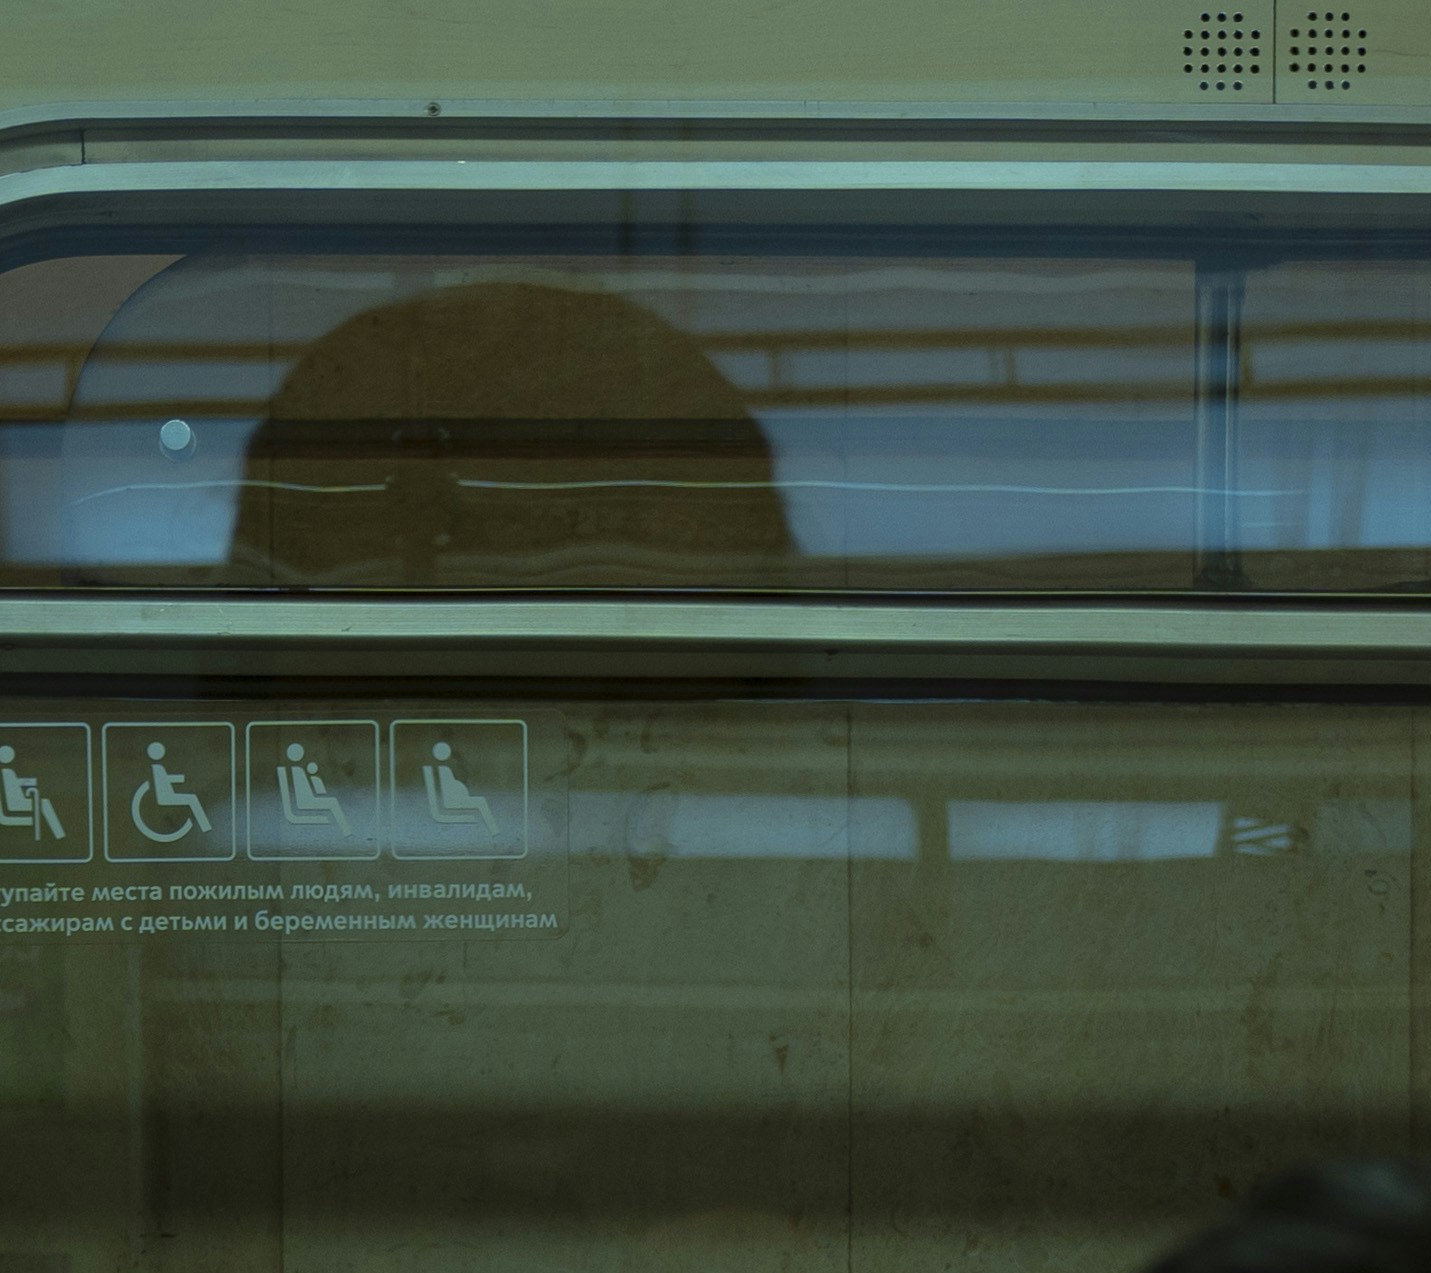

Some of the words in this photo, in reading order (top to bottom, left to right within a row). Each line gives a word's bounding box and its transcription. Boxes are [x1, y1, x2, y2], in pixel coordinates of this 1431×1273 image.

[91, 884, 163, 901] места
[169, 883, 284, 900] пожилым
[291, 884, 381, 902] людям,
[388, 882, 532, 901] инвалидам,
[121, 917, 133, 931] с
[139, 914, 227, 933] детьми
[235, 915, 248, 930] и
[254, 909, 417, 935] беременным
[423, 913, 558, 931] женщинам
